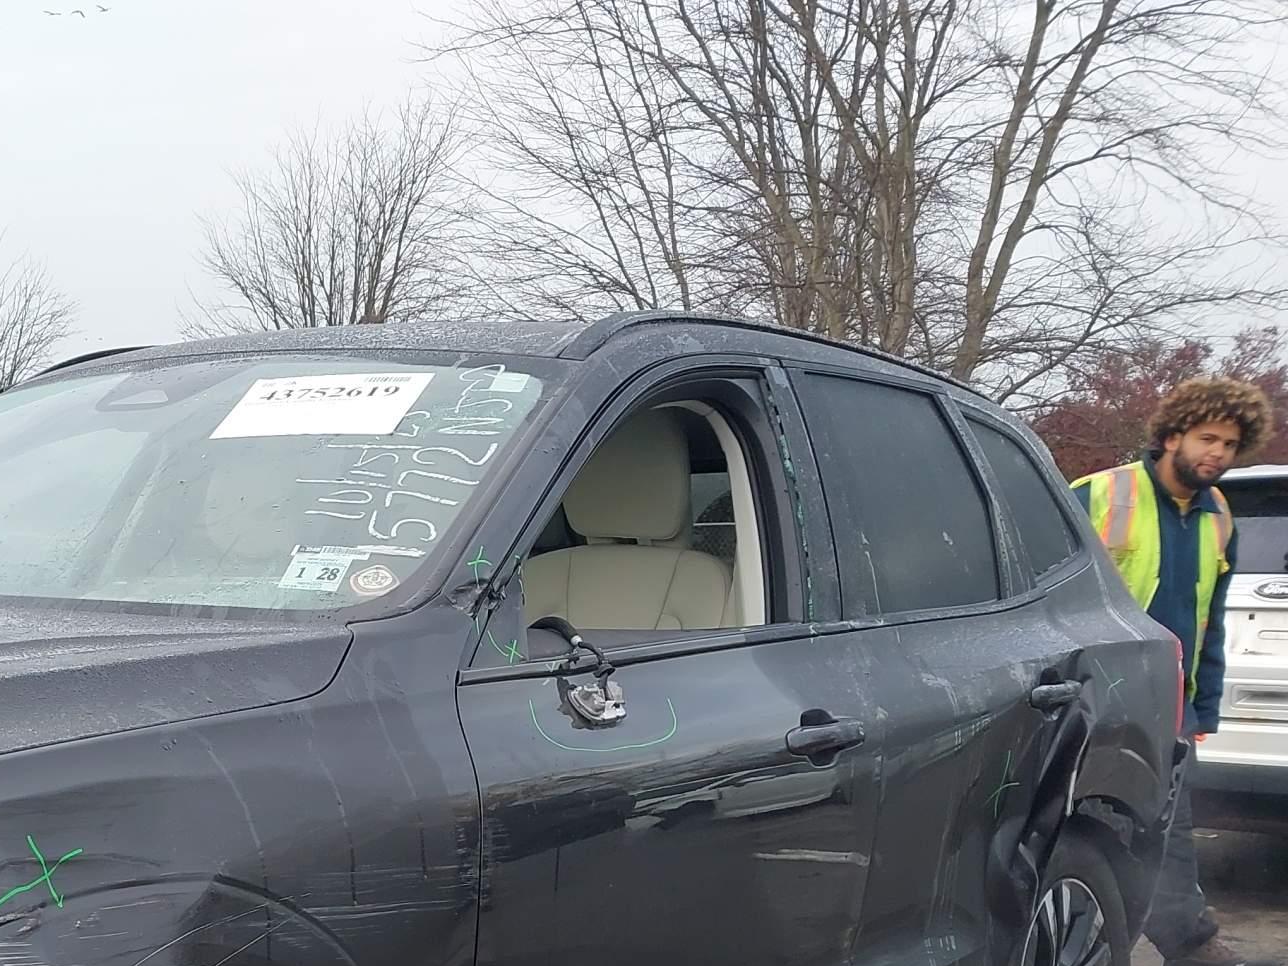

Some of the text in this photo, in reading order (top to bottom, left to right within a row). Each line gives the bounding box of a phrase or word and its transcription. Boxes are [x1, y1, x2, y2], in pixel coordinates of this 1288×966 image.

[260, 385, 401, 402] 43752619
[296, 566, 307, 579] 1
[316, 566, 341, 581] 28
